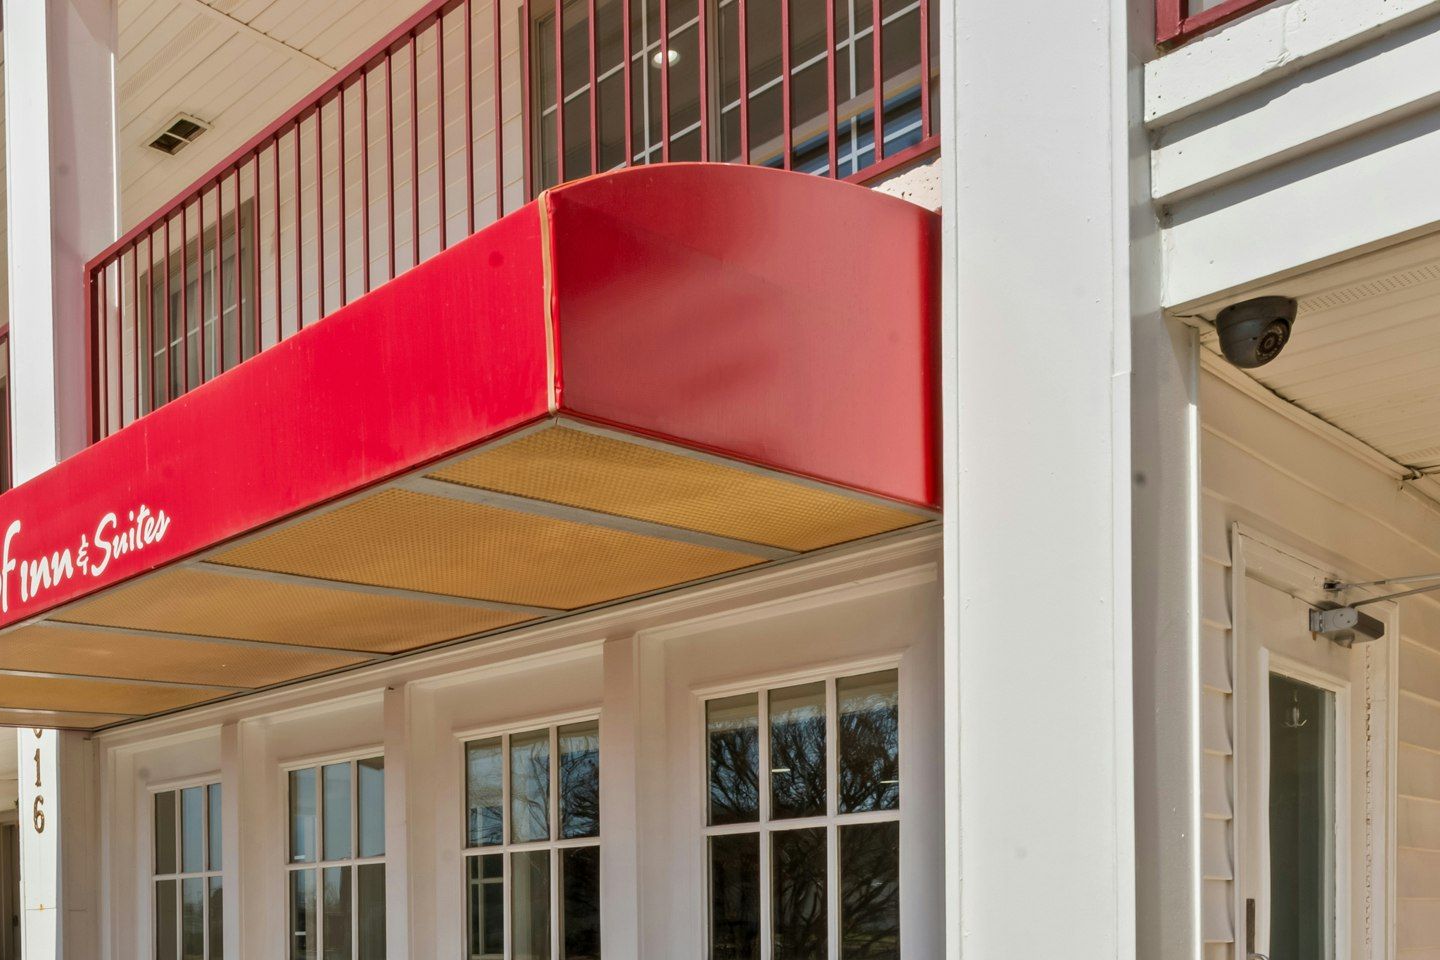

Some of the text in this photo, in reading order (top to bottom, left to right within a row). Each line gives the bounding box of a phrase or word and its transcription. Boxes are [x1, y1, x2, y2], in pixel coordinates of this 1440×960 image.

[76, 533, 90, 575] &
[91, 504, 171, 577] Suites
[32, 728, 45, 834] 16
